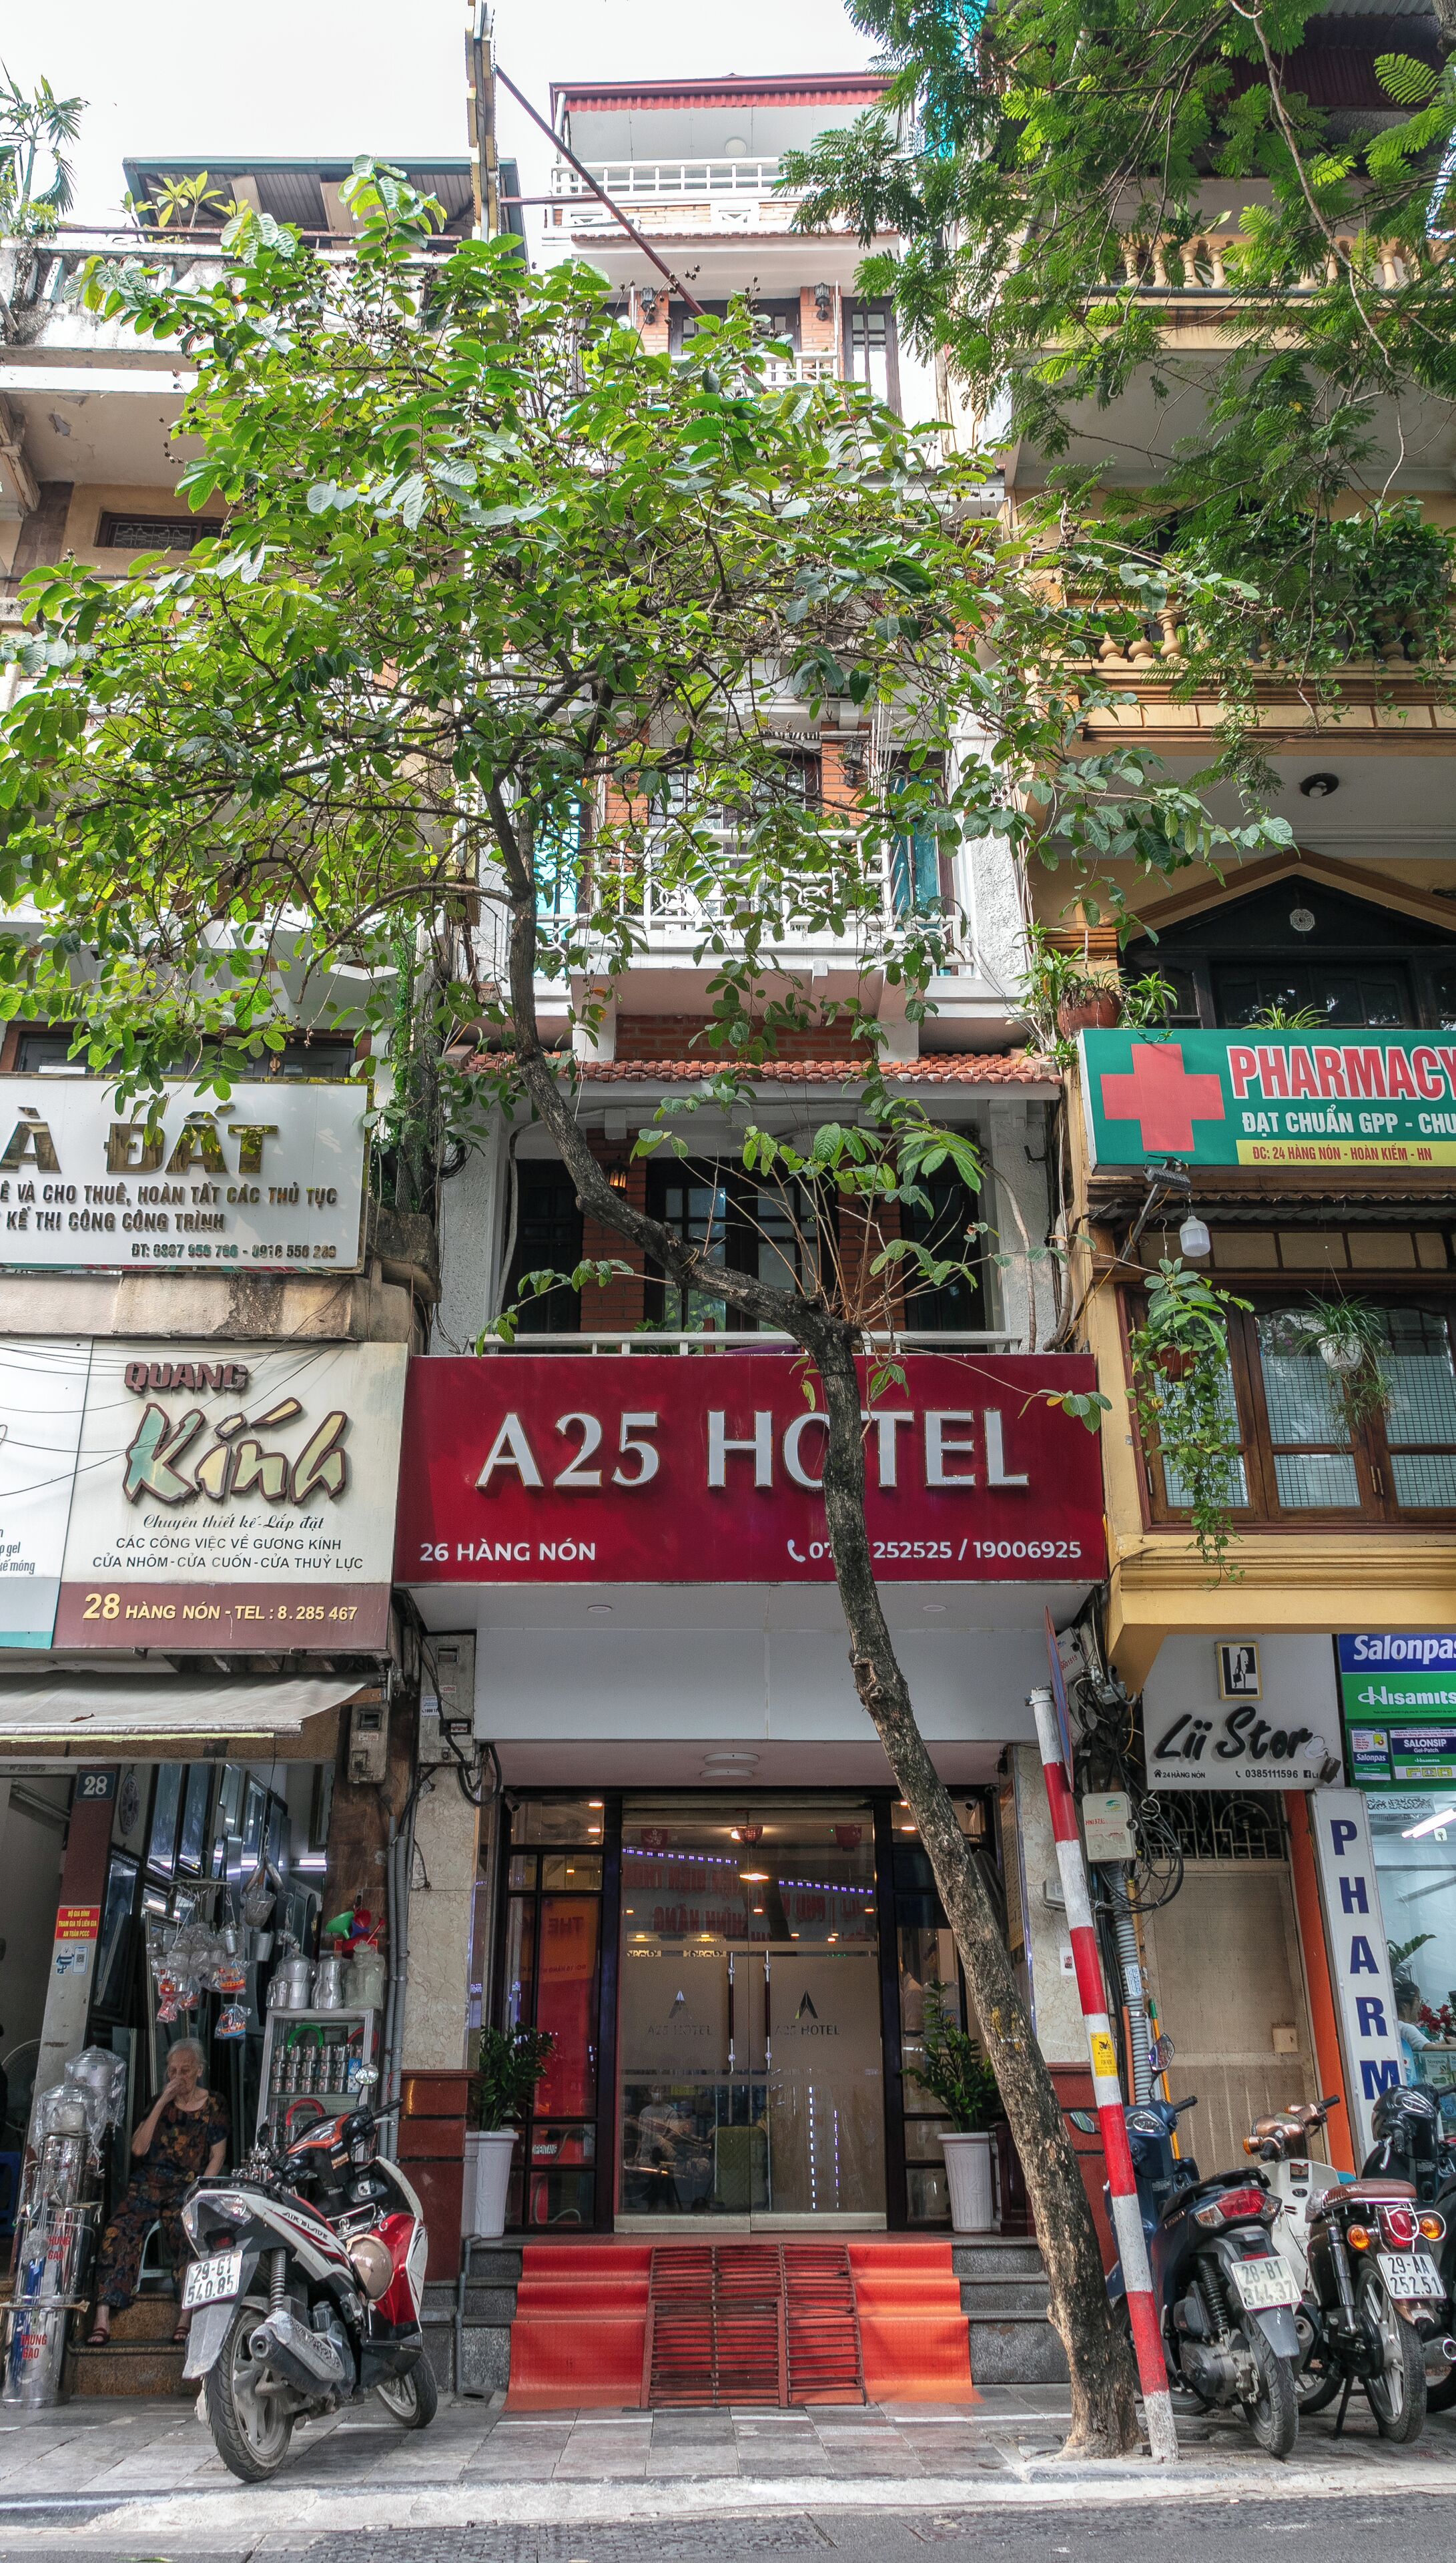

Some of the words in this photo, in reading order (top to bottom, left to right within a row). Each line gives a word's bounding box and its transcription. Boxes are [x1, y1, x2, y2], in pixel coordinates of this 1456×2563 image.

[1226, 1045, 1456, 1101] PHARMACY
[1242, 1113, 1279, 1137] ĐẠT
[1285, 1105, 1355, 1133] CHUẨN
[1359, 1113, 1398, 1133] GPP
[103, 1105, 279, 1175] ĐẤT
[1252, 1147, 1270, 1160] ĐC:
[1272, 1147, 1286, 1160] 24
[1288, 1143, 1316, 1160] HÀNG
[1319, 1143, 1341, 1160] NÓN
[1351, 1143, 1379, 1161] HOÀN
[1382, 1142, 1409, 1161] KIẾM
[1417, 1147, 1433, 1161] HN
[17, 1180, 35, 1203] VÀ
[43, 1184, 77, 1204] CHO
[137, 1182, 186, 1205] HOÀN
[190, 1181, 221, 1205] TẤT
[226, 1183, 261, 1205] CÁC
[268, 1181, 300, 1206] THỦ
[306, 1187, 338, 1211] TỤC
[35, 1211, 61, 1230] THI
[68, 1209, 116, 1232] CÔNG
[121, 1209, 169, 1232] CÔNG
[174, 1209, 226, 1232] TRÌNH
[252, 1245, 283, 1259] 0916
[124, 1362, 251, 1393] QUANG
[122, 1397, 350, 1505] Kính
[474, 1410, 661, 1488] A25
[706, 1408, 1030, 1488] HOTEL
[143, 1514, 199, 1530] Chuyên
[202, 1512, 236, 1529] thiết
[299, 1514, 325, 1530] đặt
[6, 1541, 21, 1557] gel
[116, 1534, 145, 1549] CÁC
[149, 1535, 190, 1549] CÔNG
[195, 1534, 226, 1550] VIỆC
[231, 1533, 249, 1549] VỀ
[253, 1537, 304, 1550] GƯƠNG
[308, 1536, 342, 1550] KÍNH
[420, 1542, 450, 1561] 26
[457, 1538, 530, 1561] HÀNG
[539, 1538, 596, 1561] NÓN
[873, 1540, 952, 1558] 252525
[958, 1538, 968, 1560] /
[973, 1540, 1082, 1558] 19006925
[9, 1559, 35, 1575] móng
[93, 1552, 121, 1568] CỬA
[294, 1553, 331, 1569] THUỶ
[336, 1556, 364, 1571] LỰC
[83, 1593, 121, 1621] 28
[125, 1601, 177, 1620] HÀNG
[183, 1601, 221, 1620] NÓN
[328, 1607, 359, 1621] 467
[1354, 1635, 1456, 1665] Salonpa
[1154, 1713, 1213, 1761] Lii
[1403, 1739, 1447, 1747] SALONSIP
[1357, 1753, 1386, 1763] Salonpas
[1171, 1769, 1190, 1779] HÀNG
[1192, 1769, 1206, 1779] NÓN
[1245, 1770, 1299, 1779] 0385111596
[83, 1776, 108, 1795] 28
[801, 2024, 840, 2036] HOTEL
[194, 2255, 232, 2284] 29-G1
[1241, 2260, 1285, 2285] 28-B1
[1388, 2257, 1431, 2275] 29-AA
[1391, 2276, 1441, 2295] 252.51
[22, 2348, 39, 2361] GẠO
